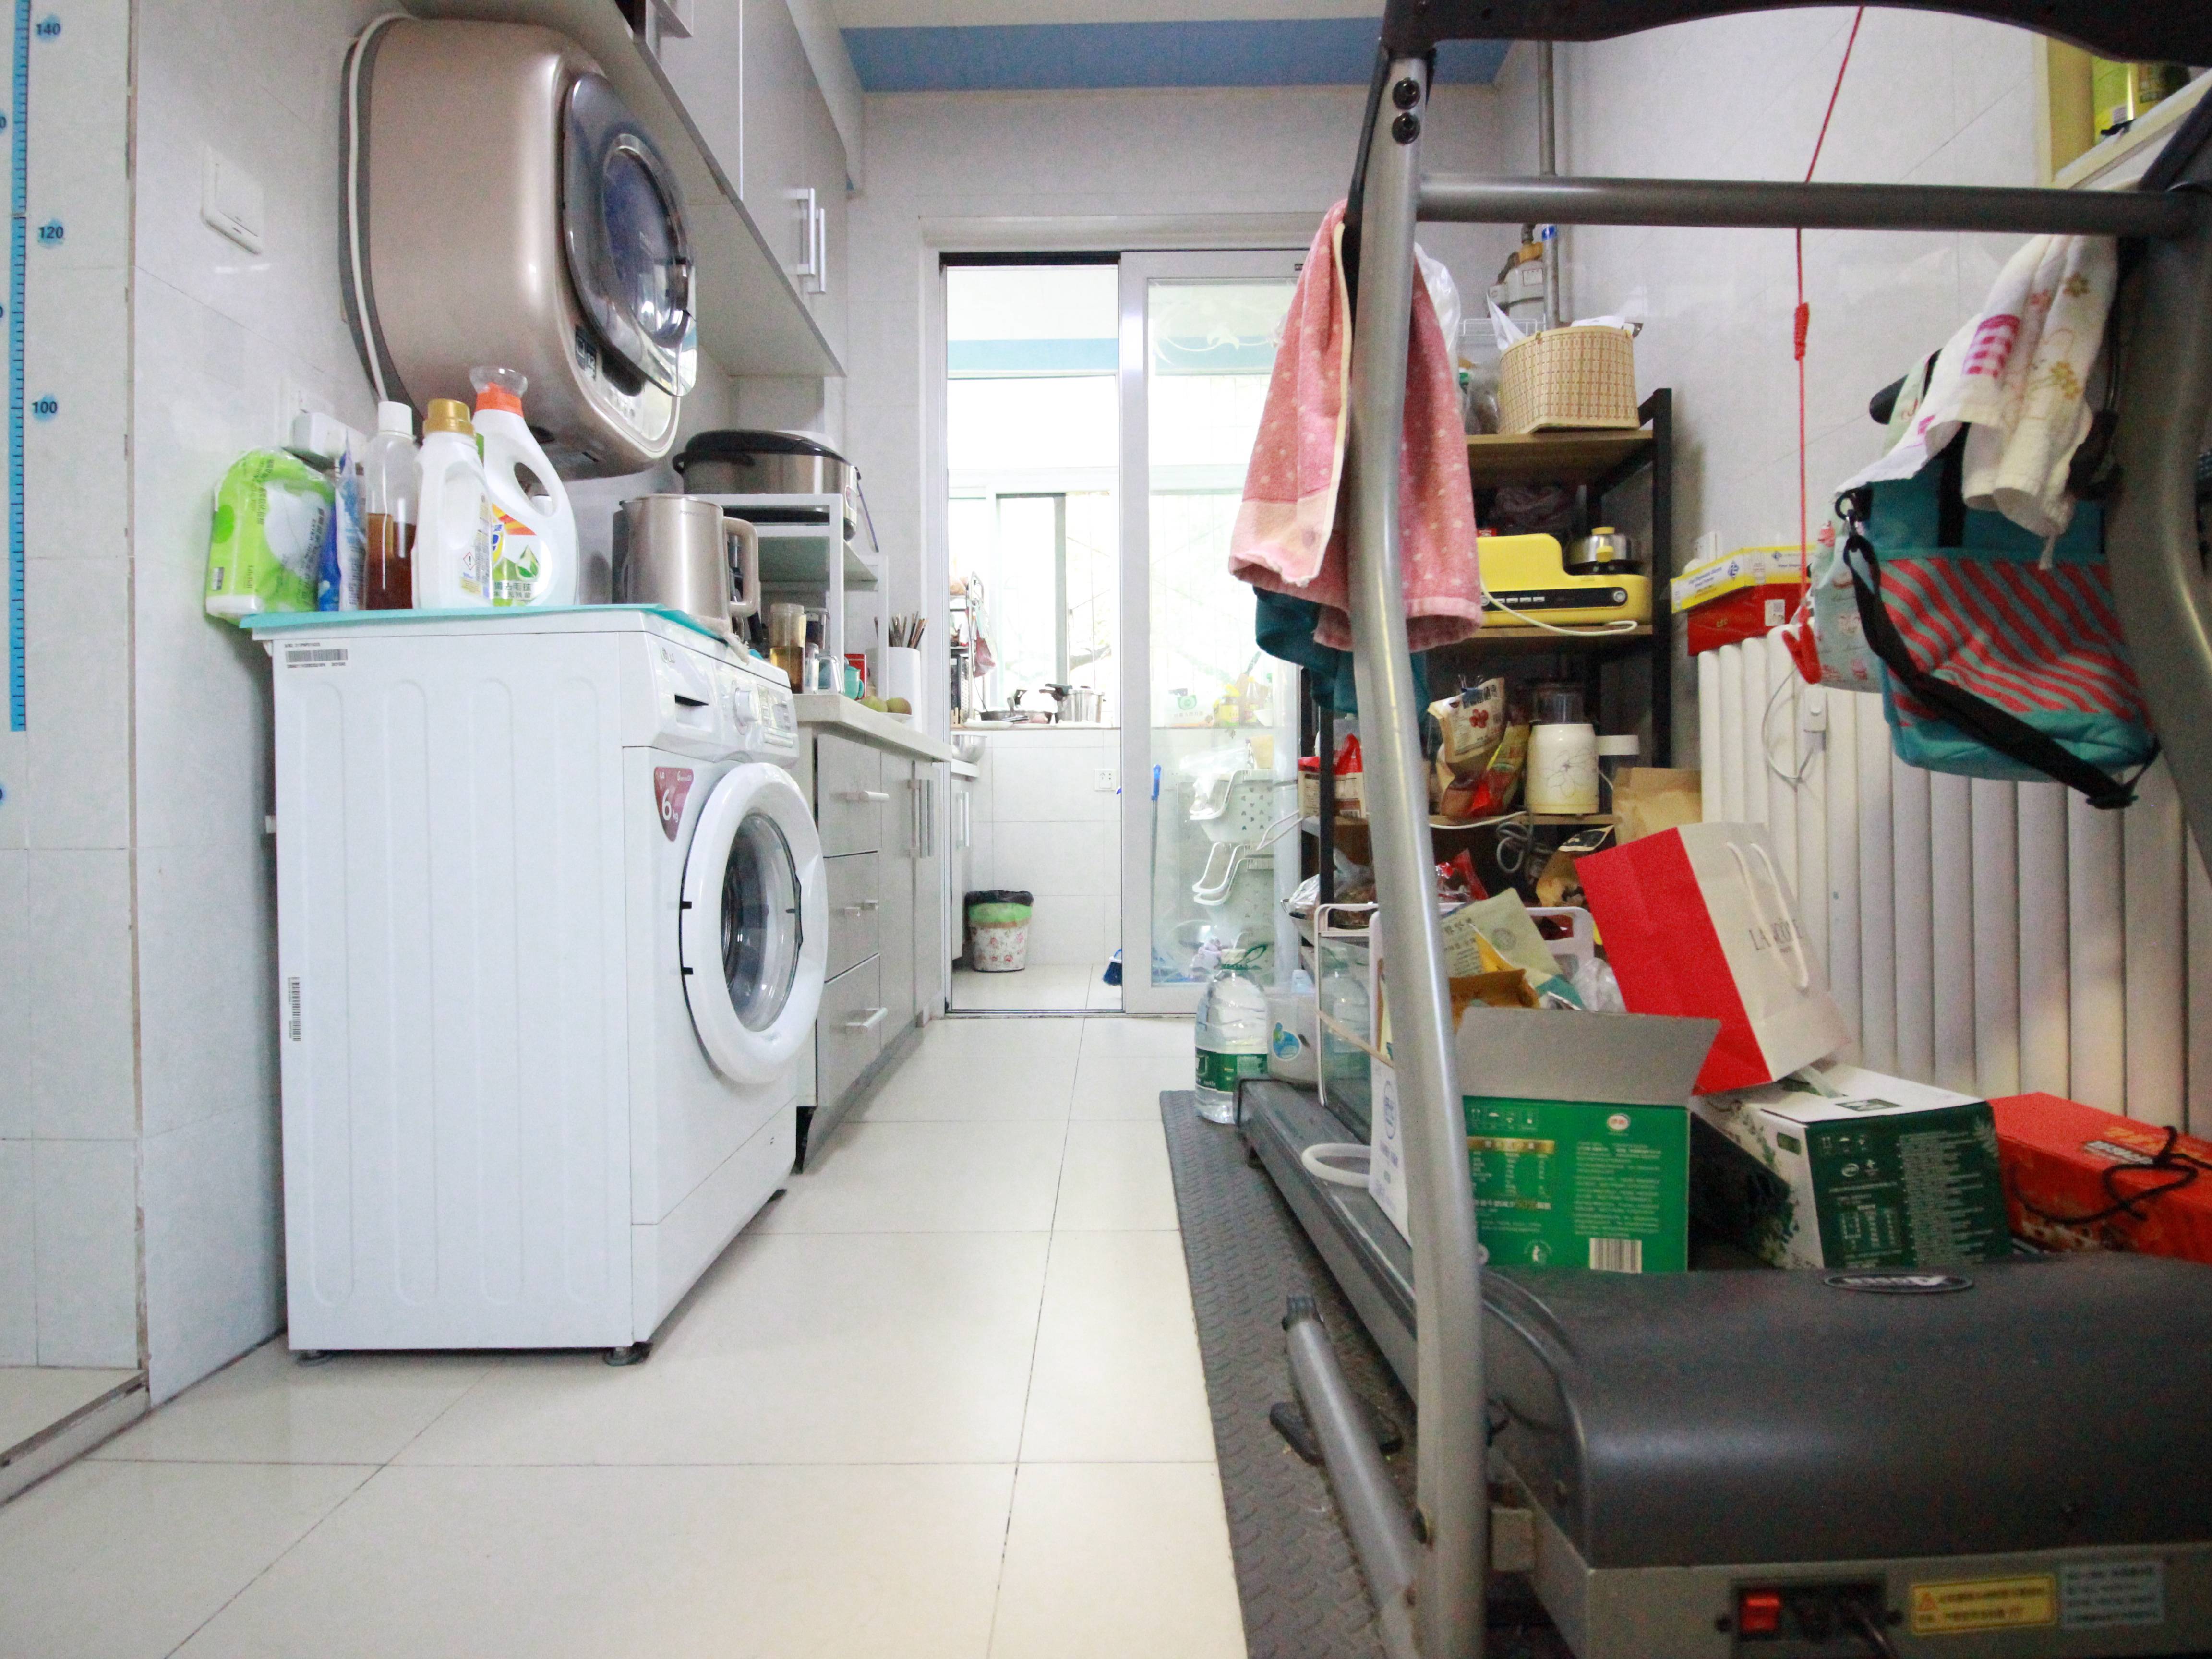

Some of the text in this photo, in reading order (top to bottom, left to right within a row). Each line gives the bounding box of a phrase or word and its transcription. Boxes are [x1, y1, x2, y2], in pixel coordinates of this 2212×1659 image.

[36, 23, 61, 35] 140
[39, 227, 64, 239] 120
[32, 401, 58, 413] 100
[662, 788, 673, 821] 6
